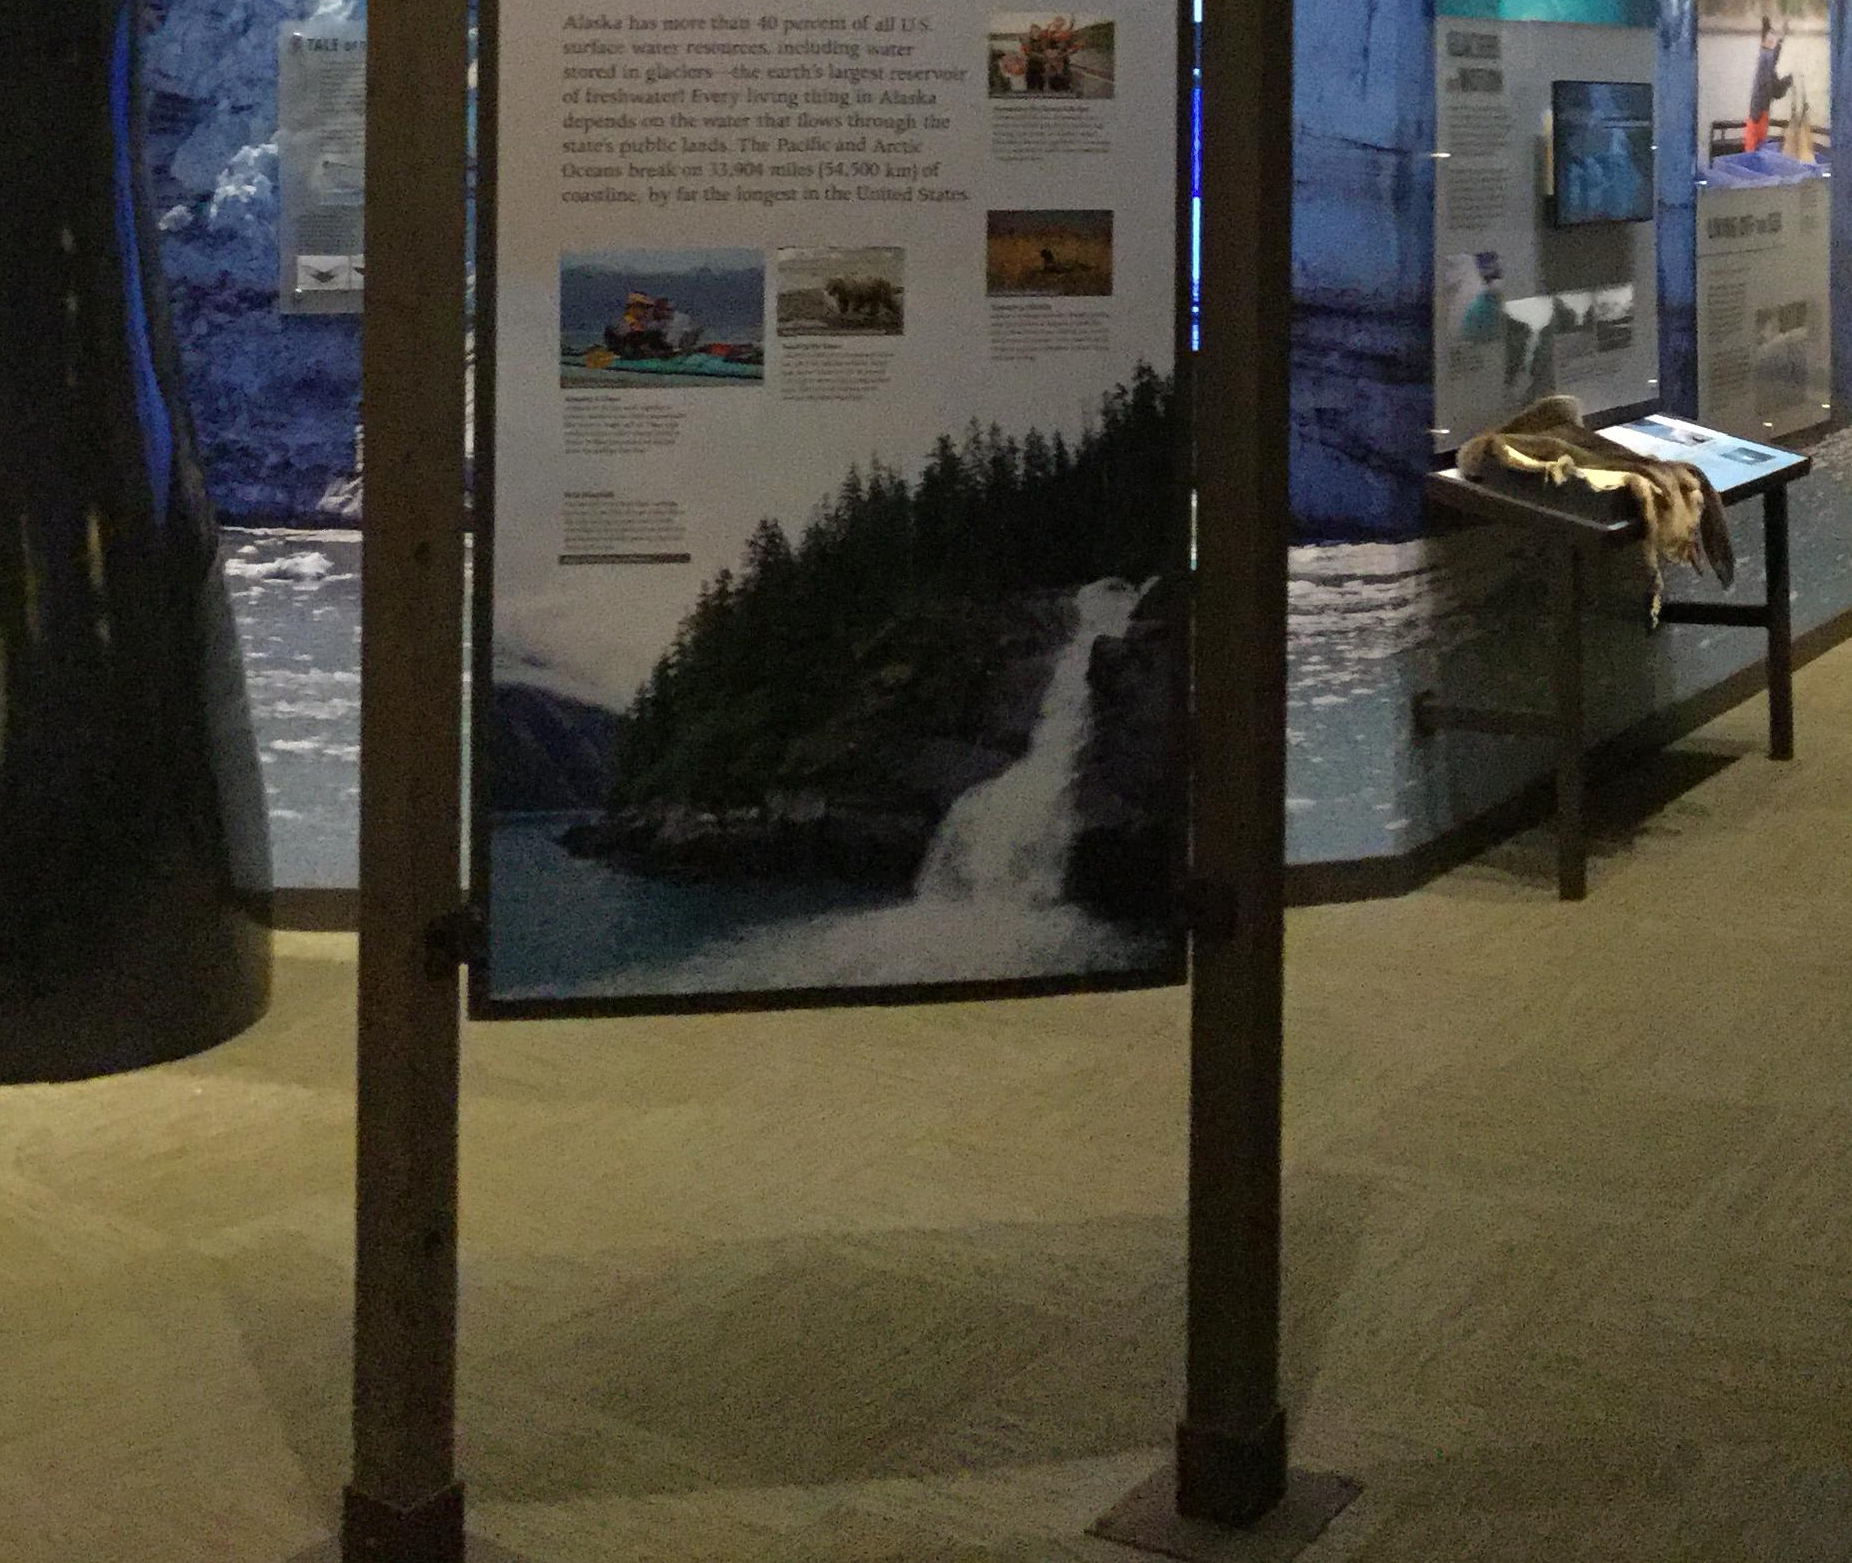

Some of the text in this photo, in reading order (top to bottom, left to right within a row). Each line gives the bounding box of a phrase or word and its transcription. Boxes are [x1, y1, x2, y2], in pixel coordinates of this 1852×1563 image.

[563, 14, 623, 30] Alaska
[629, 13, 658, 30] has
[852, 15, 871, 31] of
[879, 89, 937, 105] Alaska
